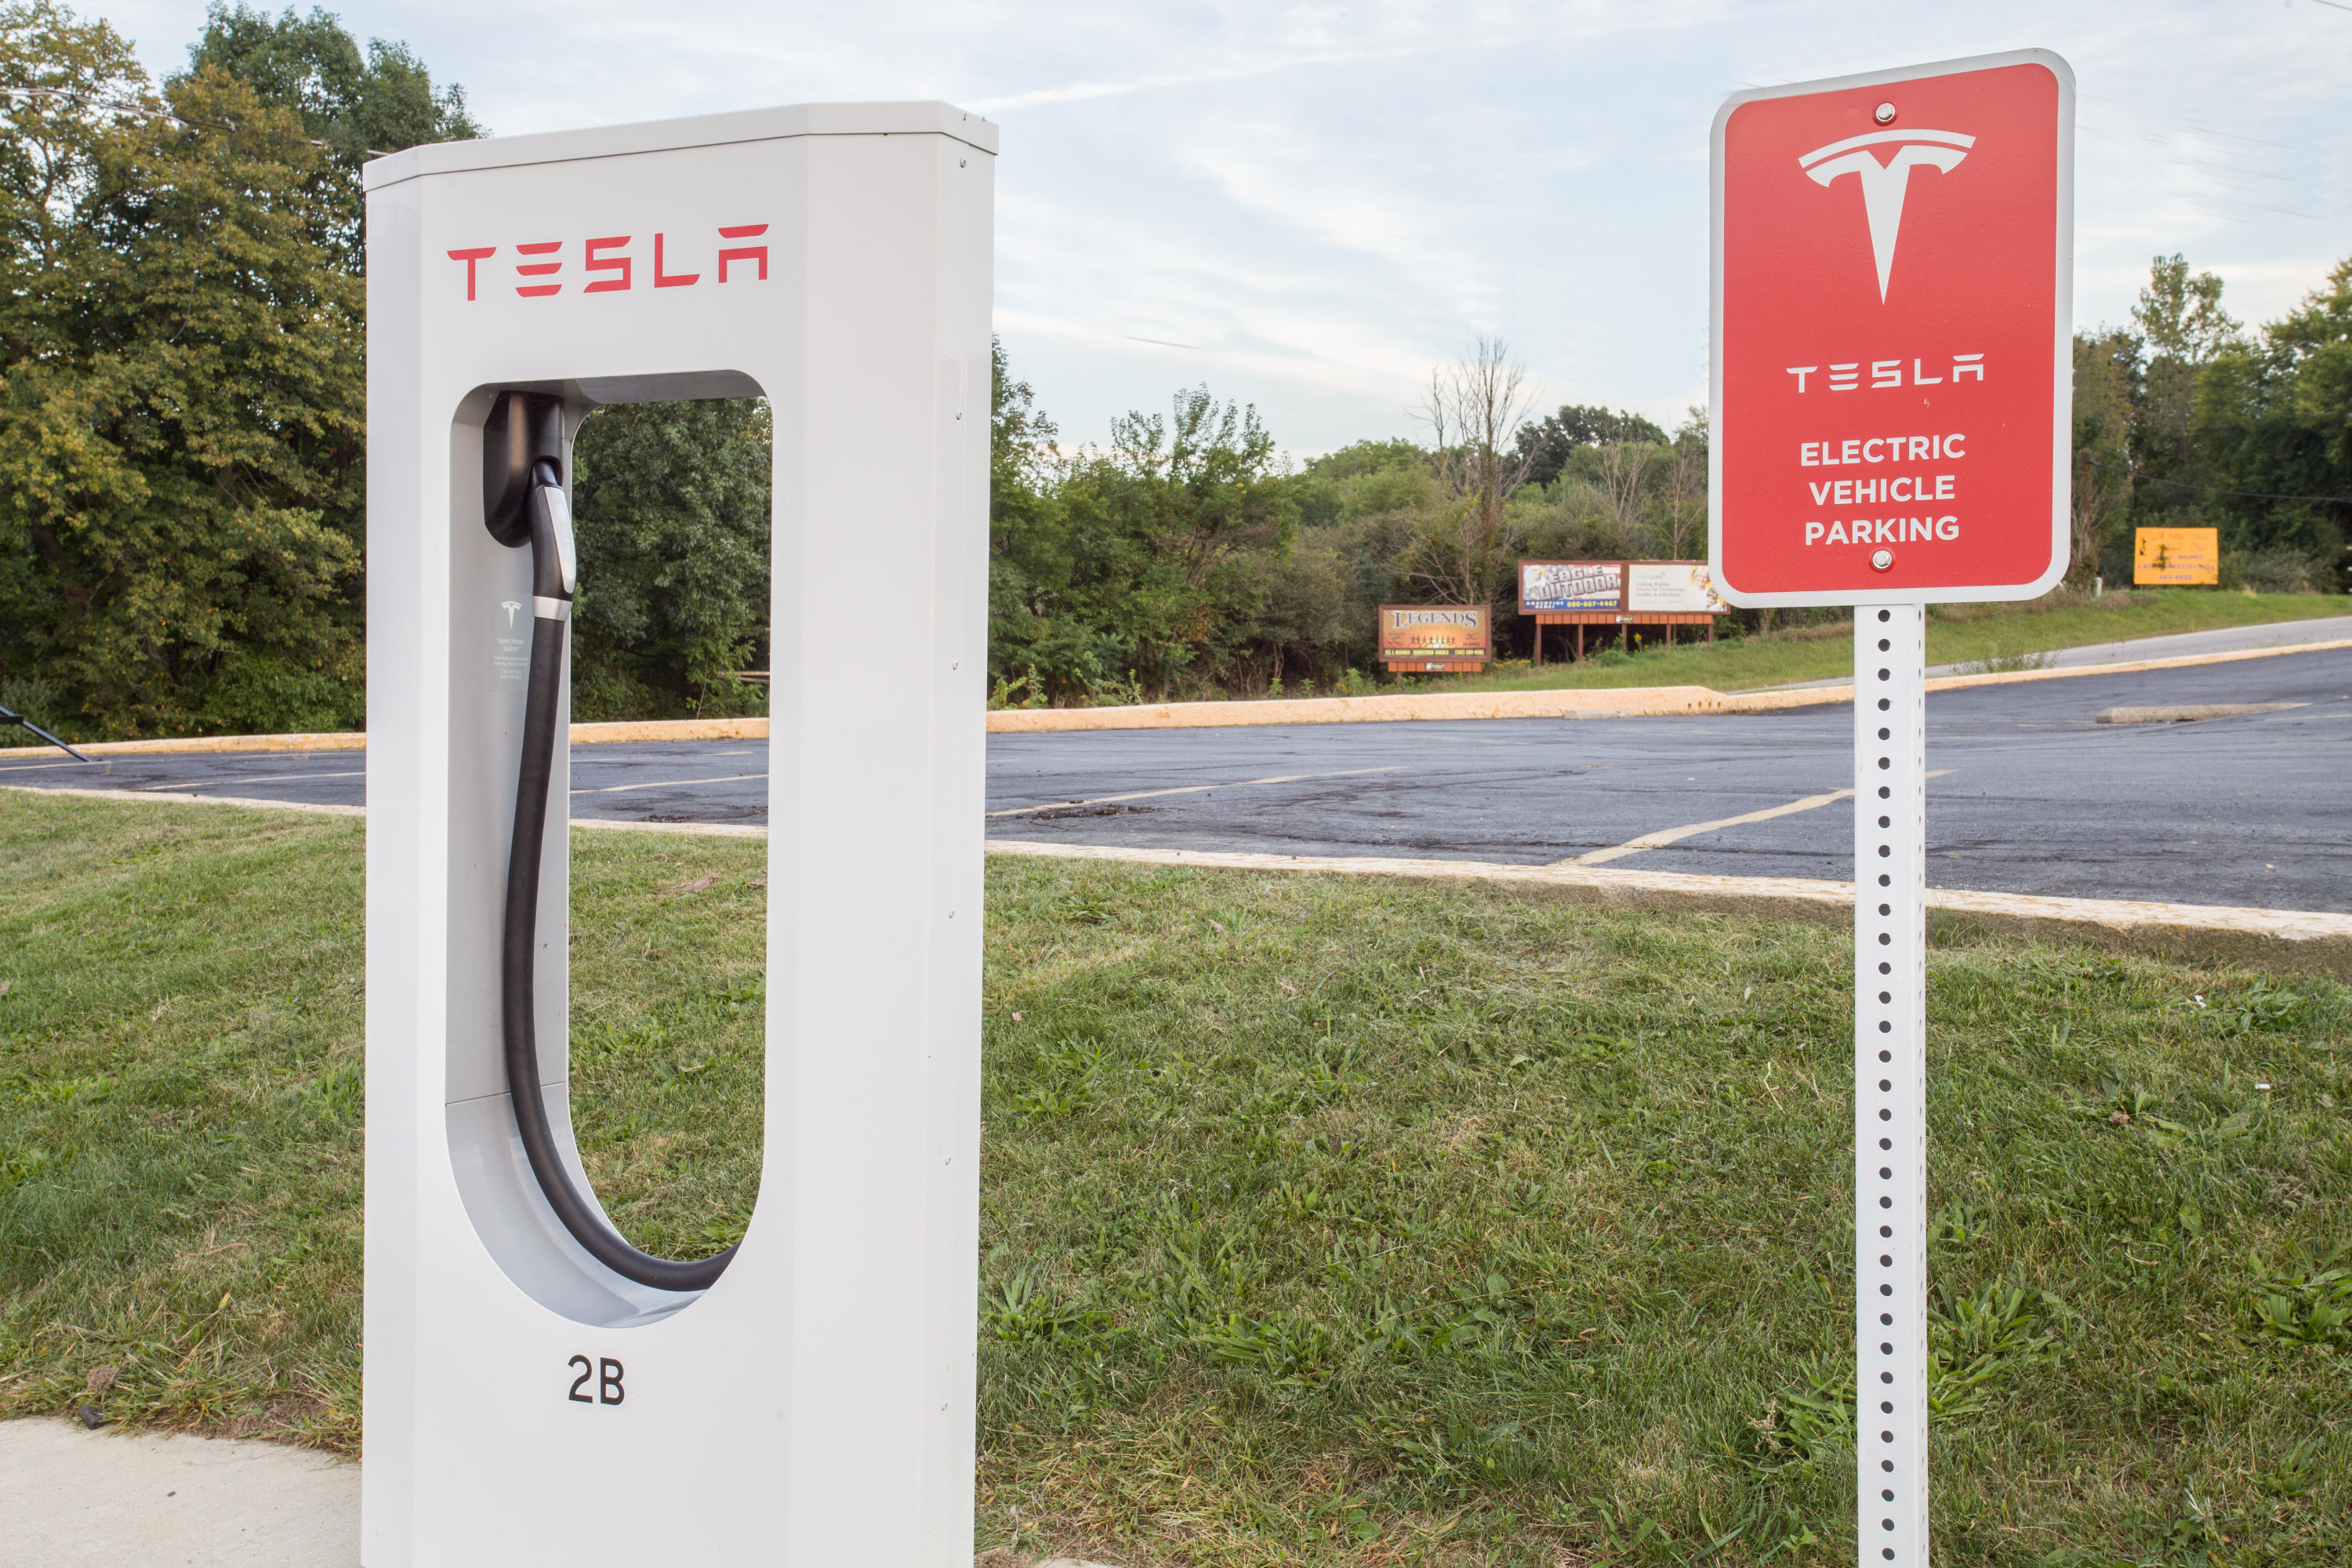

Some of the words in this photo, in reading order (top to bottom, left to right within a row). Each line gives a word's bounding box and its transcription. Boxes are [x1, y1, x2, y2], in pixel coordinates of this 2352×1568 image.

[447, 223, 769, 301] TESLA
[1786, 354, 1984, 394] TESLA
[1801, 433, 1966, 466] ELECTRIC
[1809, 474, 1955, 506] VEHICLE
[1806, 515, 1959, 546] PARKING
[1538, 574, 1619, 601] OUTDOOR
[1549, 565, 1604, 584] EAGLE
[1392, 611, 1478, 628] LEGENDS
[568, 1354, 625, 1406] 2B
